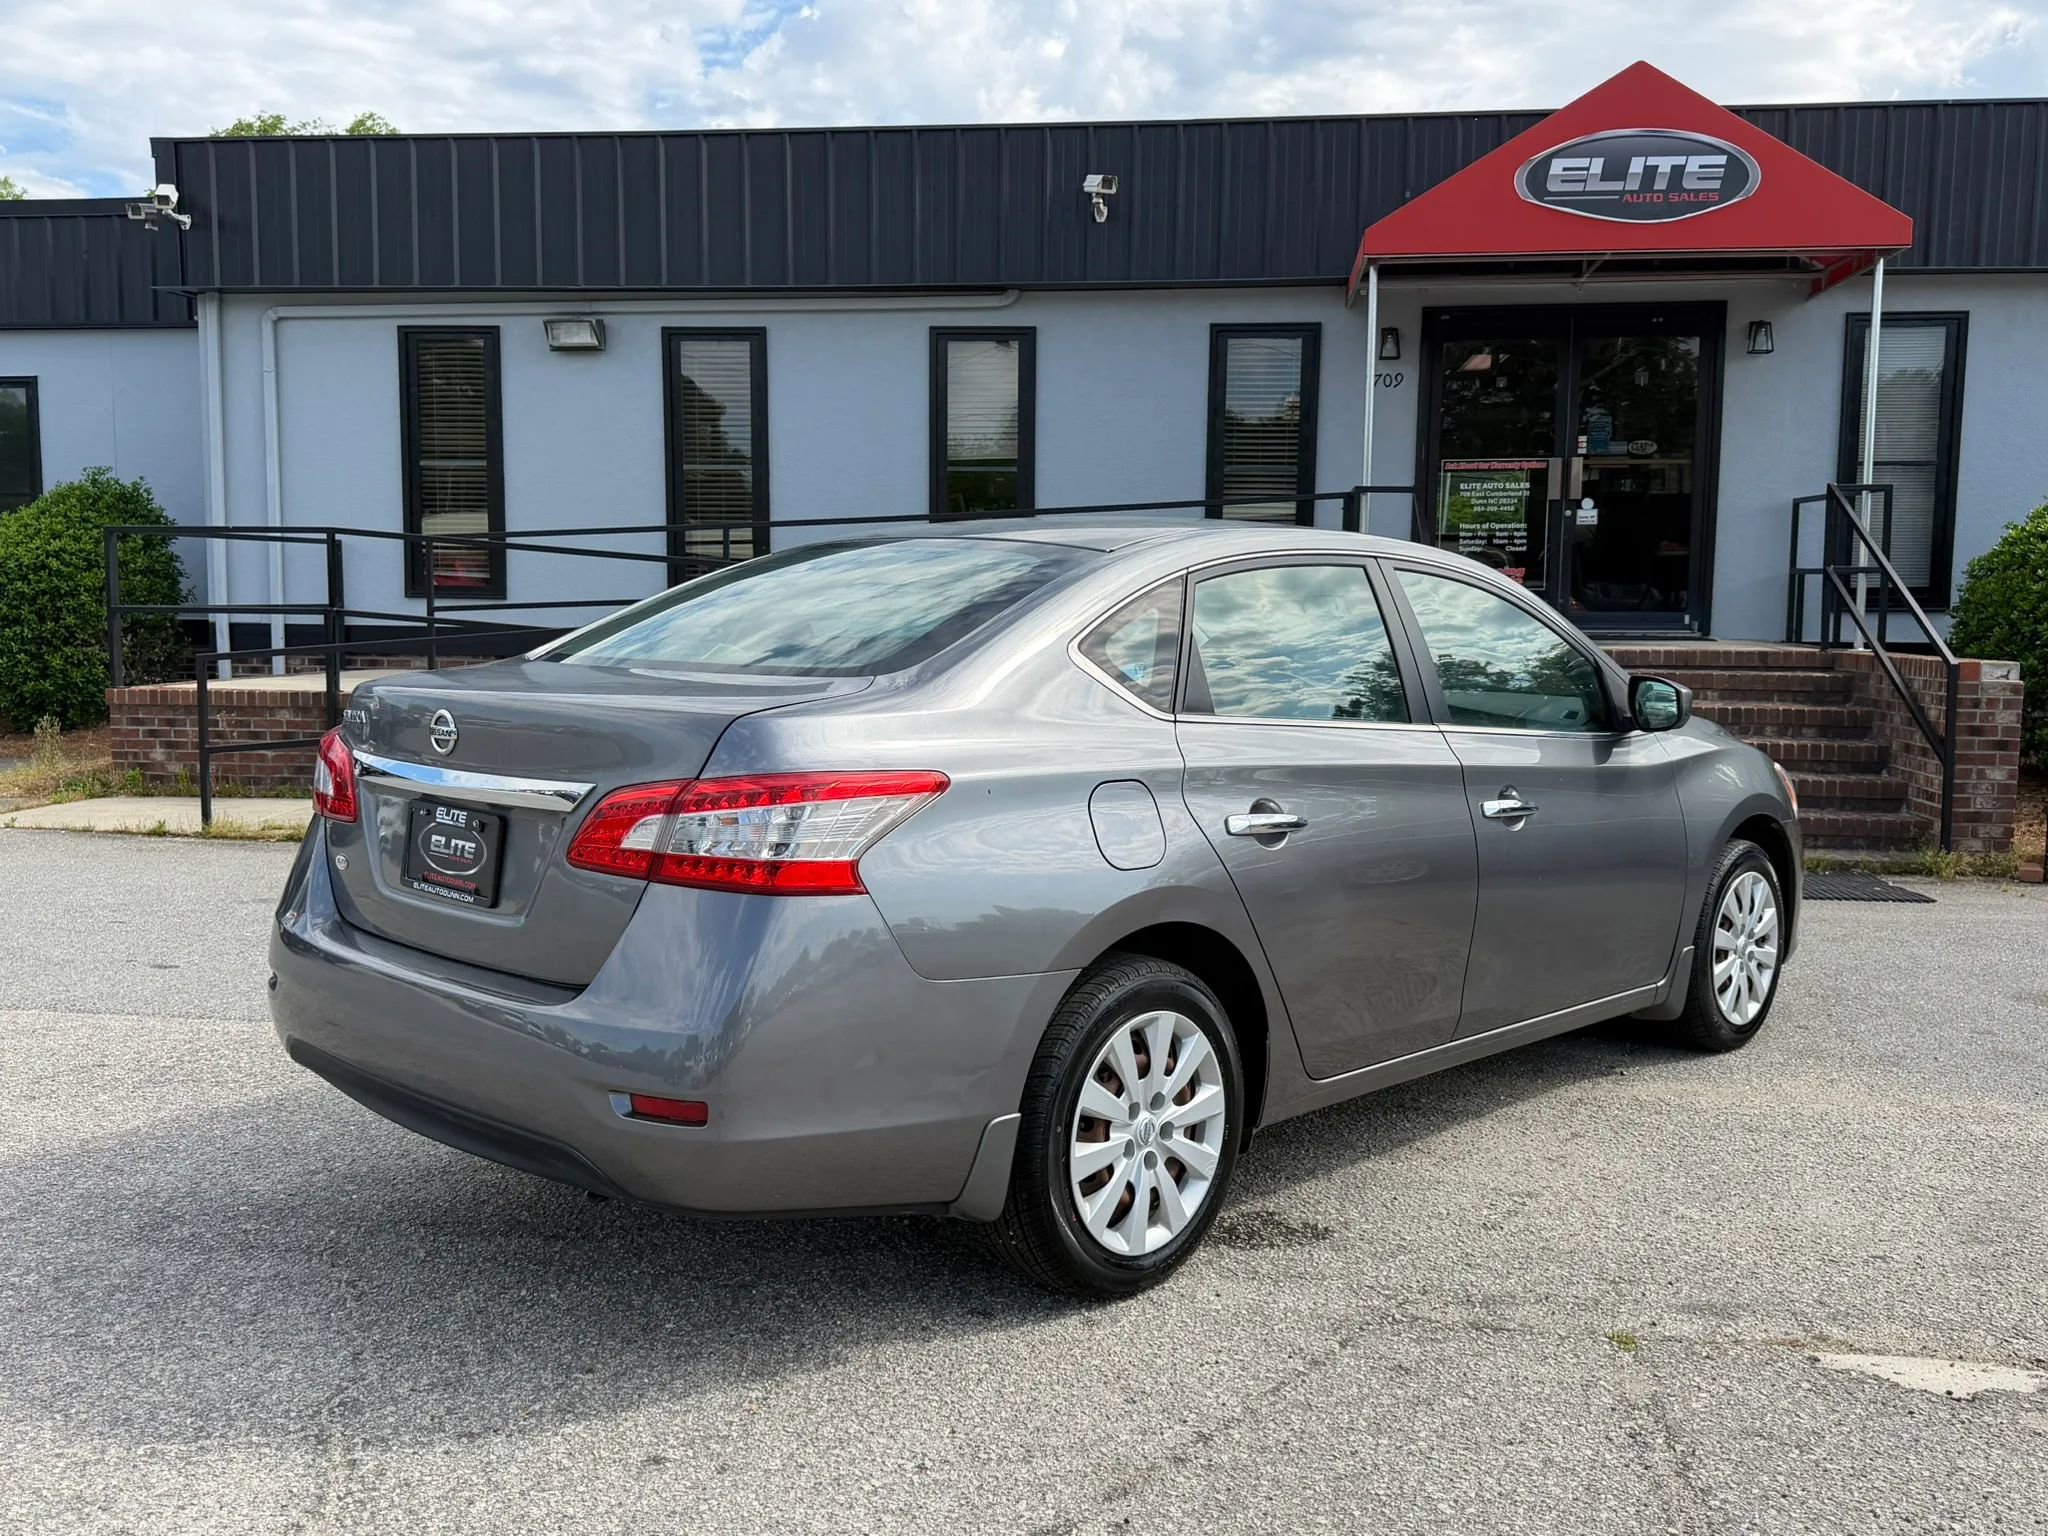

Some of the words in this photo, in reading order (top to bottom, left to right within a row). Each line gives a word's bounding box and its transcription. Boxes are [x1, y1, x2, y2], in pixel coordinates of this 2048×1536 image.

[1546, 155, 1728, 192] ELITE
[1622, 193, 1664, 203] AUTO
[1668, 192, 1719, 203] SALES
[1374, 372, 1404, 388] 709
[1490, 522, 1528, 530] Operation:
[435, 806, 468, 823] ELITE
[430, 834, 476, 859] ELITE
[413, 881, 475, 903] ELITEAUTODUNN.COM
